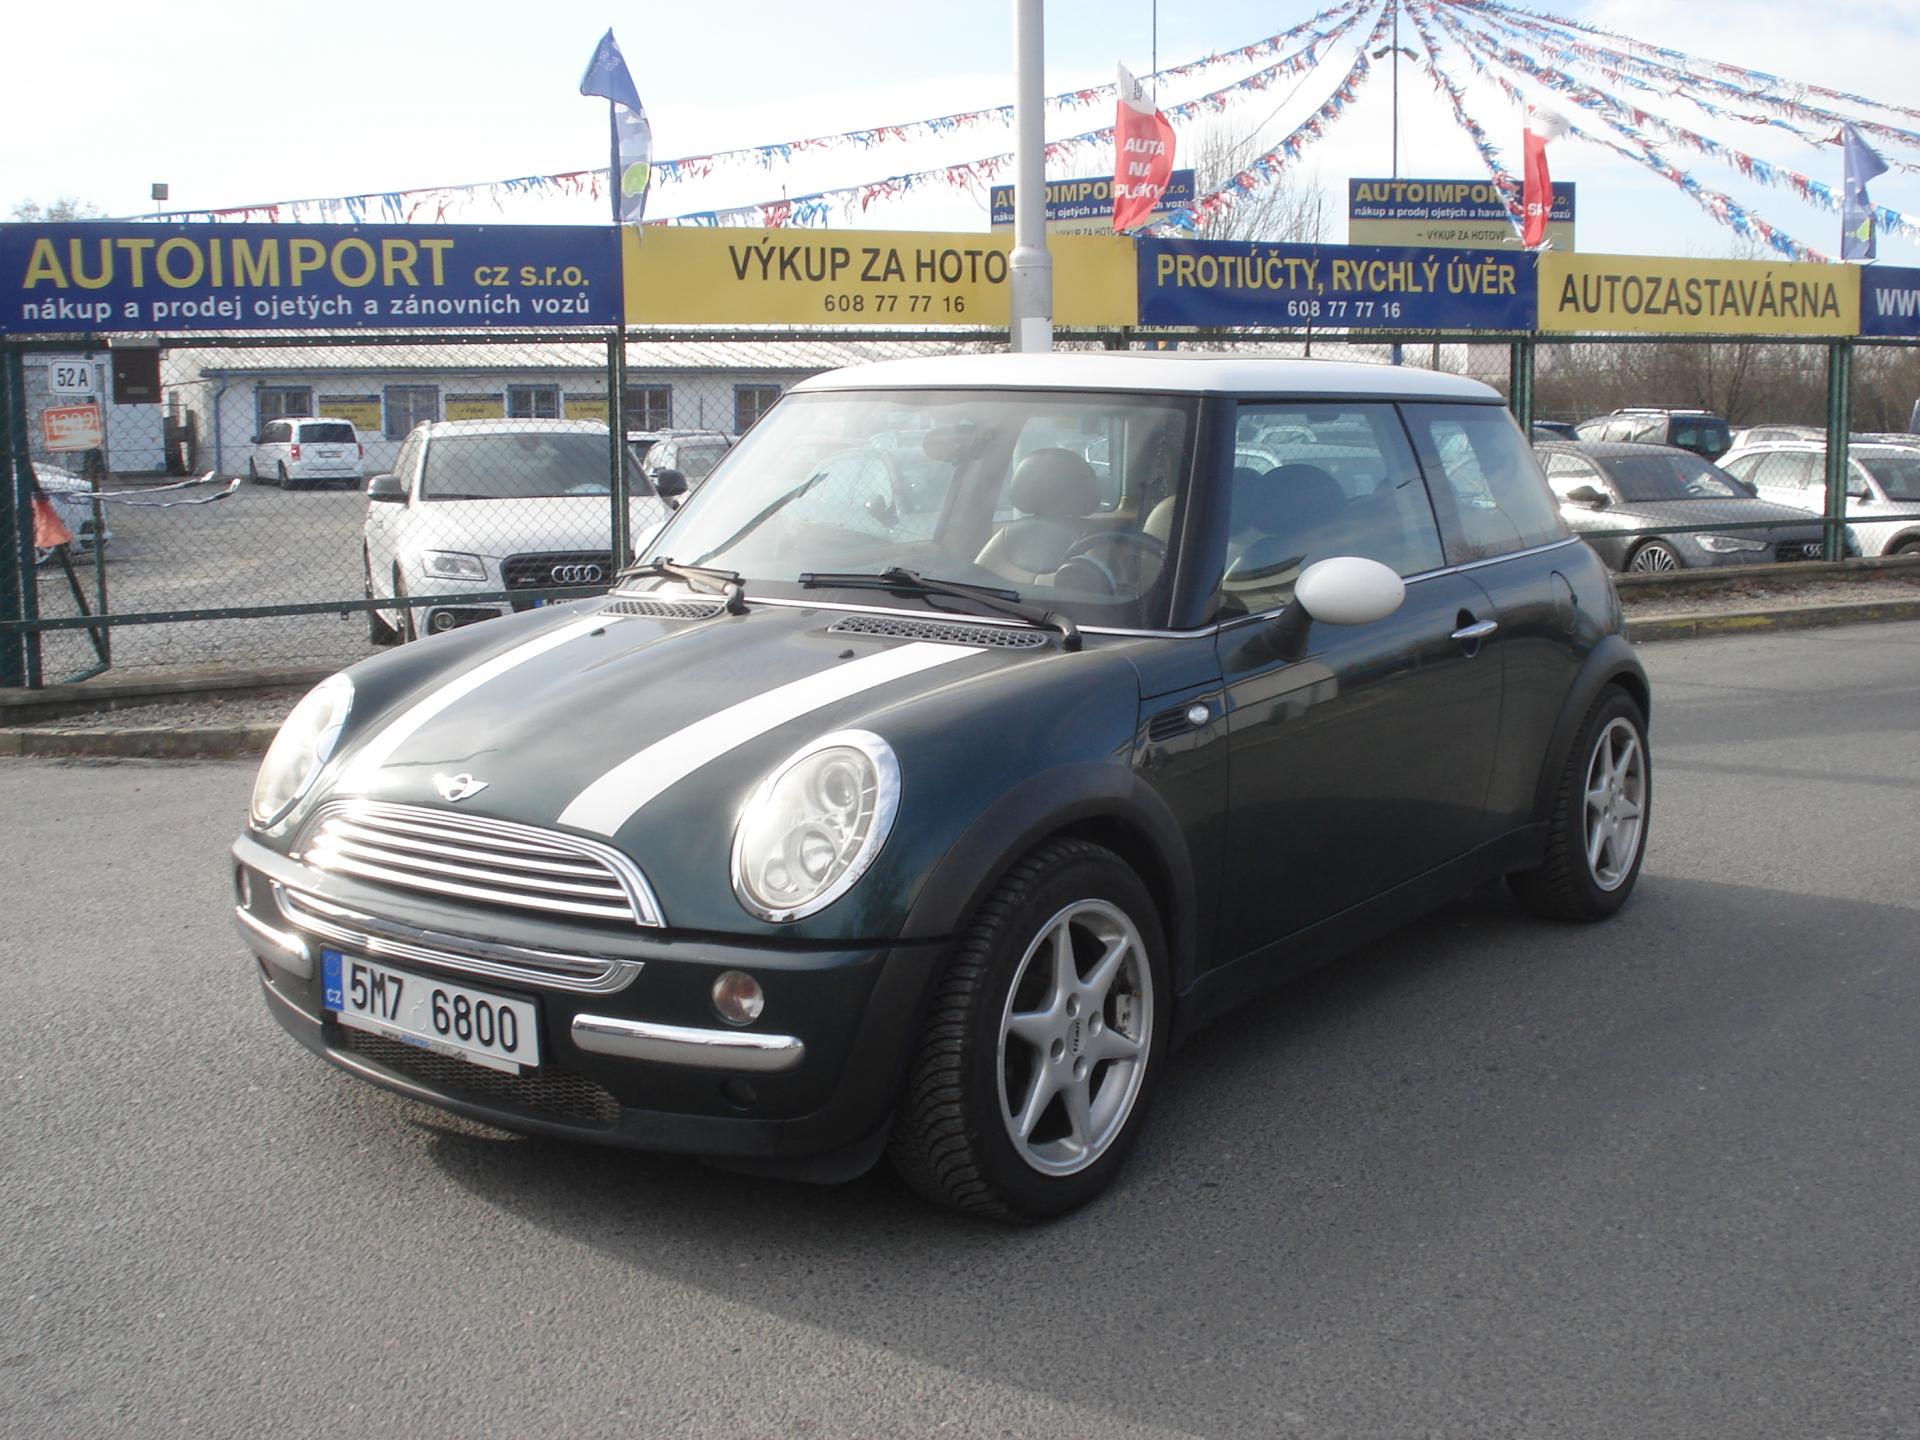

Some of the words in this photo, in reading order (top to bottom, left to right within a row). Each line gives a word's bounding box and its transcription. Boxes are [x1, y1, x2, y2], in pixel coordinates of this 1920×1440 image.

[1124, 138, 1165, 156] AUTA
[1355, 182, 1504, 204] AUTOIMPOR
[1354, 206, 1386, 218] nákup
[1388, 208, 1395, 217] a
[1396, 206, 1429, 219] prodej
[22, 236, 454, 289] AUTOIMPORT
[519, 265, 590, 287] s.r.o.
[728, 236, 851, 282] VÝKUP
[860, 248, 906, 283] ZA
[915, 249, 1010, 284] HOTO
[1156, 249, 1324, 296] PROTIÚČTY,
[1332, 254, 1441, 294] RYCHLÝ
[1447, 254, 1516, 295] ÚVĚR
[22, 297, 112, 323] nákup
[123, 302, 140, 318] a
[152, 296, 242, 322] prodej
[253, 294, 352, 320] ojetých
[363, 299, 379, 315] a
[389, 293, 521, 316] zánovních
[530, 292, 590, 314] vozů
[823, 294, 865, 313] 608
[874, 295, 898, 313] 77
[908, 295, 932, 313] 77
[942, 295, 965, 313] 16
[1558, 271, 1841, 319] AUTOZASTAVÁRNA
[1287, 299, 1321, 318] 608
[1327, 300, 1348, 318] 77
[1354, 301, 1374, 318] 77
[1382, 301, 1401, 319] 16
[326, 987, 342, 1004] CZ
[351, 962, 404, 1021] 5M7
[431, 988, 519, 1053] 6800
